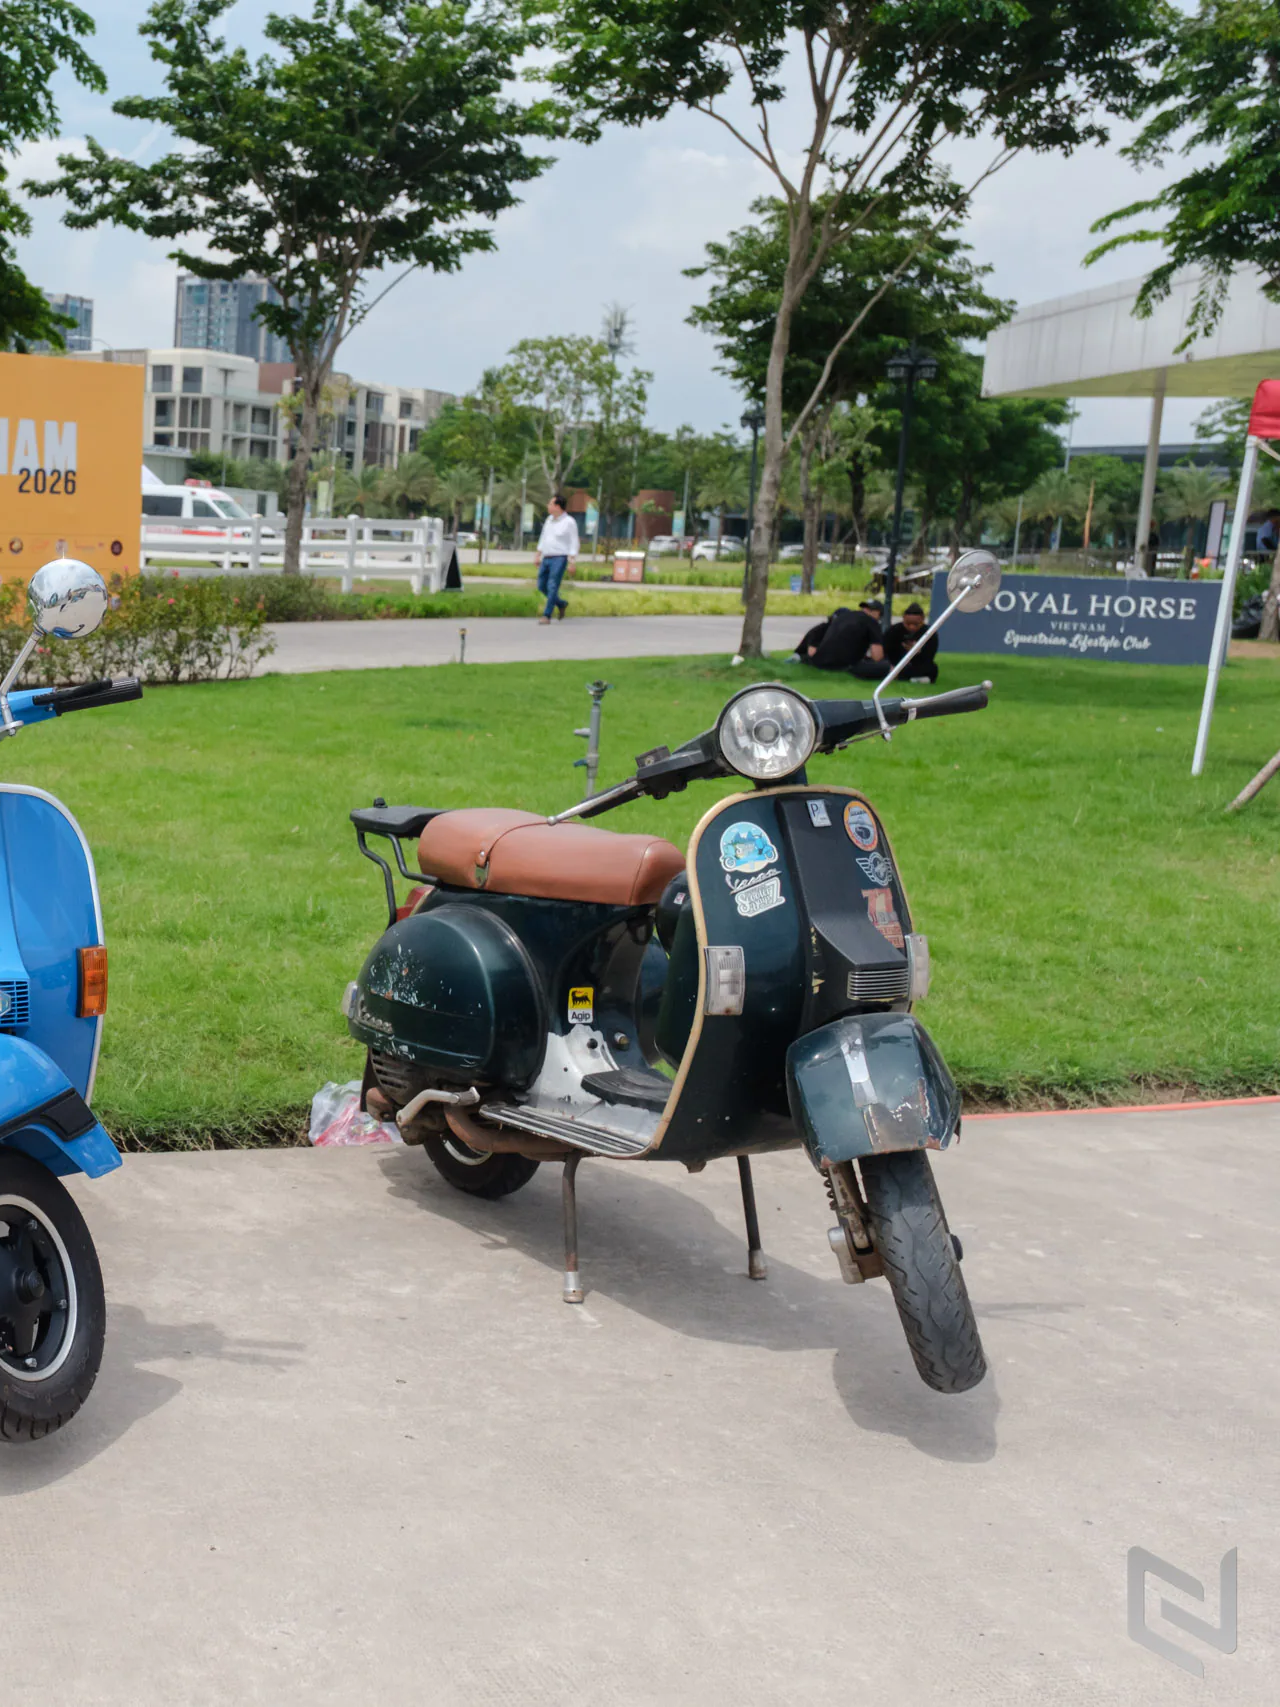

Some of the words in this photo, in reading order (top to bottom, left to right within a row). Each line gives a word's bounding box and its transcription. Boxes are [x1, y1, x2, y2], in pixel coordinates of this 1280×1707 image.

[18, 467, 77, 495] 2026
[984, 590, 1079, 616] OYAL
[1088, 594, 1197, 620] HORSE
[1050, 620, 1106, 632] VIETNAM
[1004, 629, 1067, 648] Equestrian
[1069, 632, 1120, 653] Lifestyle
[1122, 635, 1151, 650] Club
[810, 803, 819, 817] P
[571, 1011, 591, 1021] Agip
